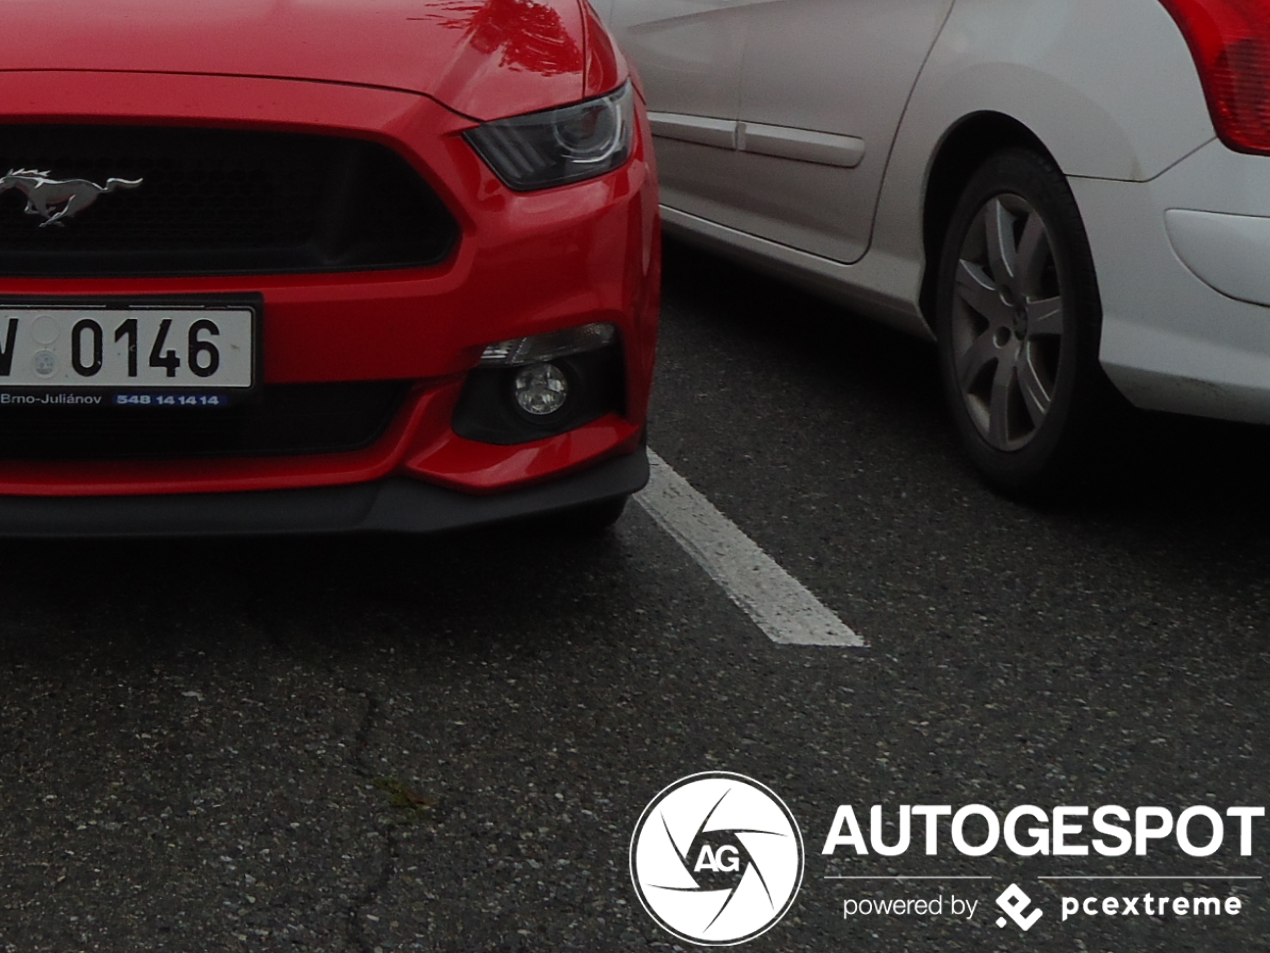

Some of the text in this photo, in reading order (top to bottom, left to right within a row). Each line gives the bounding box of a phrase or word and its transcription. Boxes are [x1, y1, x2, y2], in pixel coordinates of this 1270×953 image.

[71, 318, 220, 378] 0146
[0, 393, 102, 405] Brno-Juliánov
[116, 395, 151, 404] 548
